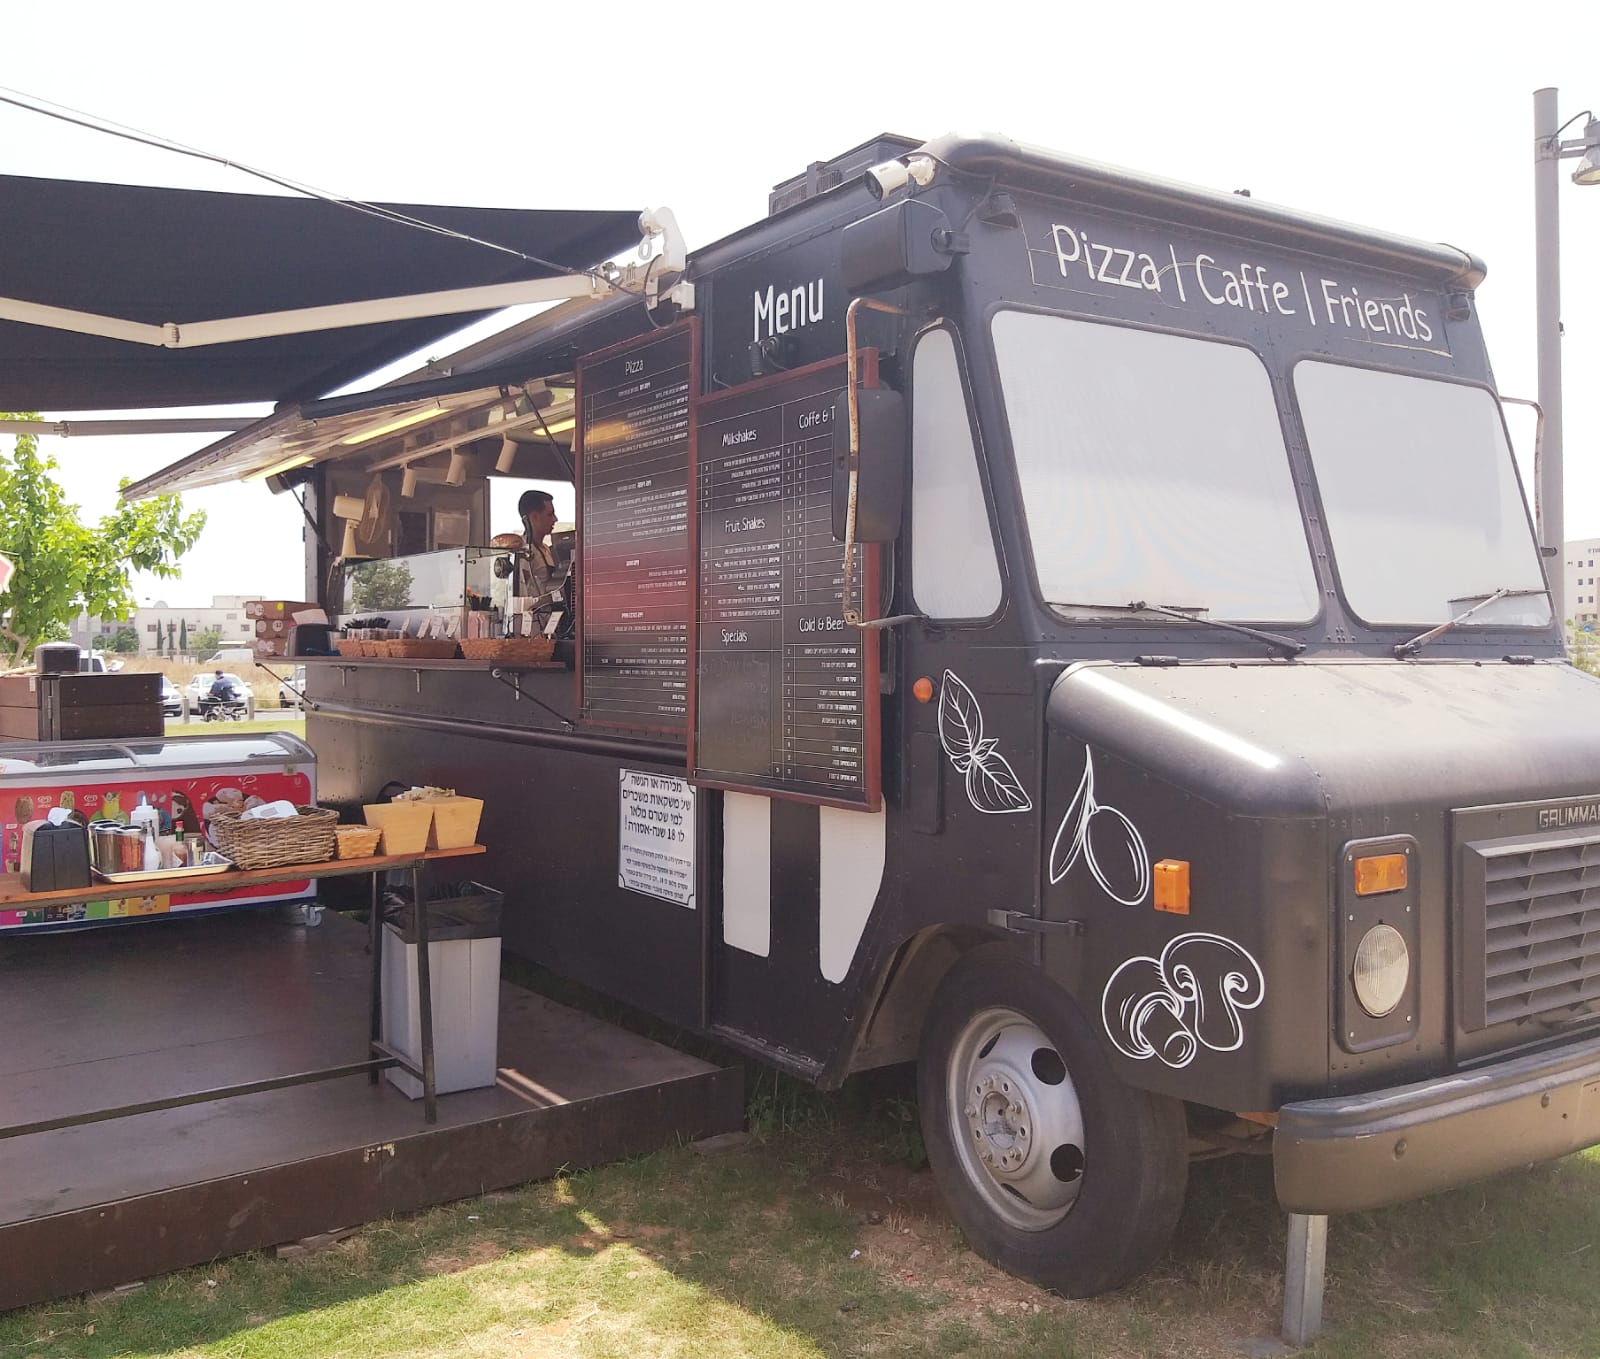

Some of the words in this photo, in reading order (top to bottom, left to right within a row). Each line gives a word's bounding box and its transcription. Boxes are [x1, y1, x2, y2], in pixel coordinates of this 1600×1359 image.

[1051, 223, 1161, 292] Pizza
[1196, 254, 1296, 315] Caffe
[1319, 279, 1433, 341] Friends
[754, 278, 824, 343] Menu
[625, 360, 644, 375] Pizza
[799, 410, 820, 429] Coffe
[829, 405, 836, 420] T
[742, 516, 766, 531] Shakes
[799, 616, 816, 632] Cold
[721, 628, 748, 646] Specials
[1539, 804, 1600, 828] GRUMMA
[667, 828, 676, 840] 18
